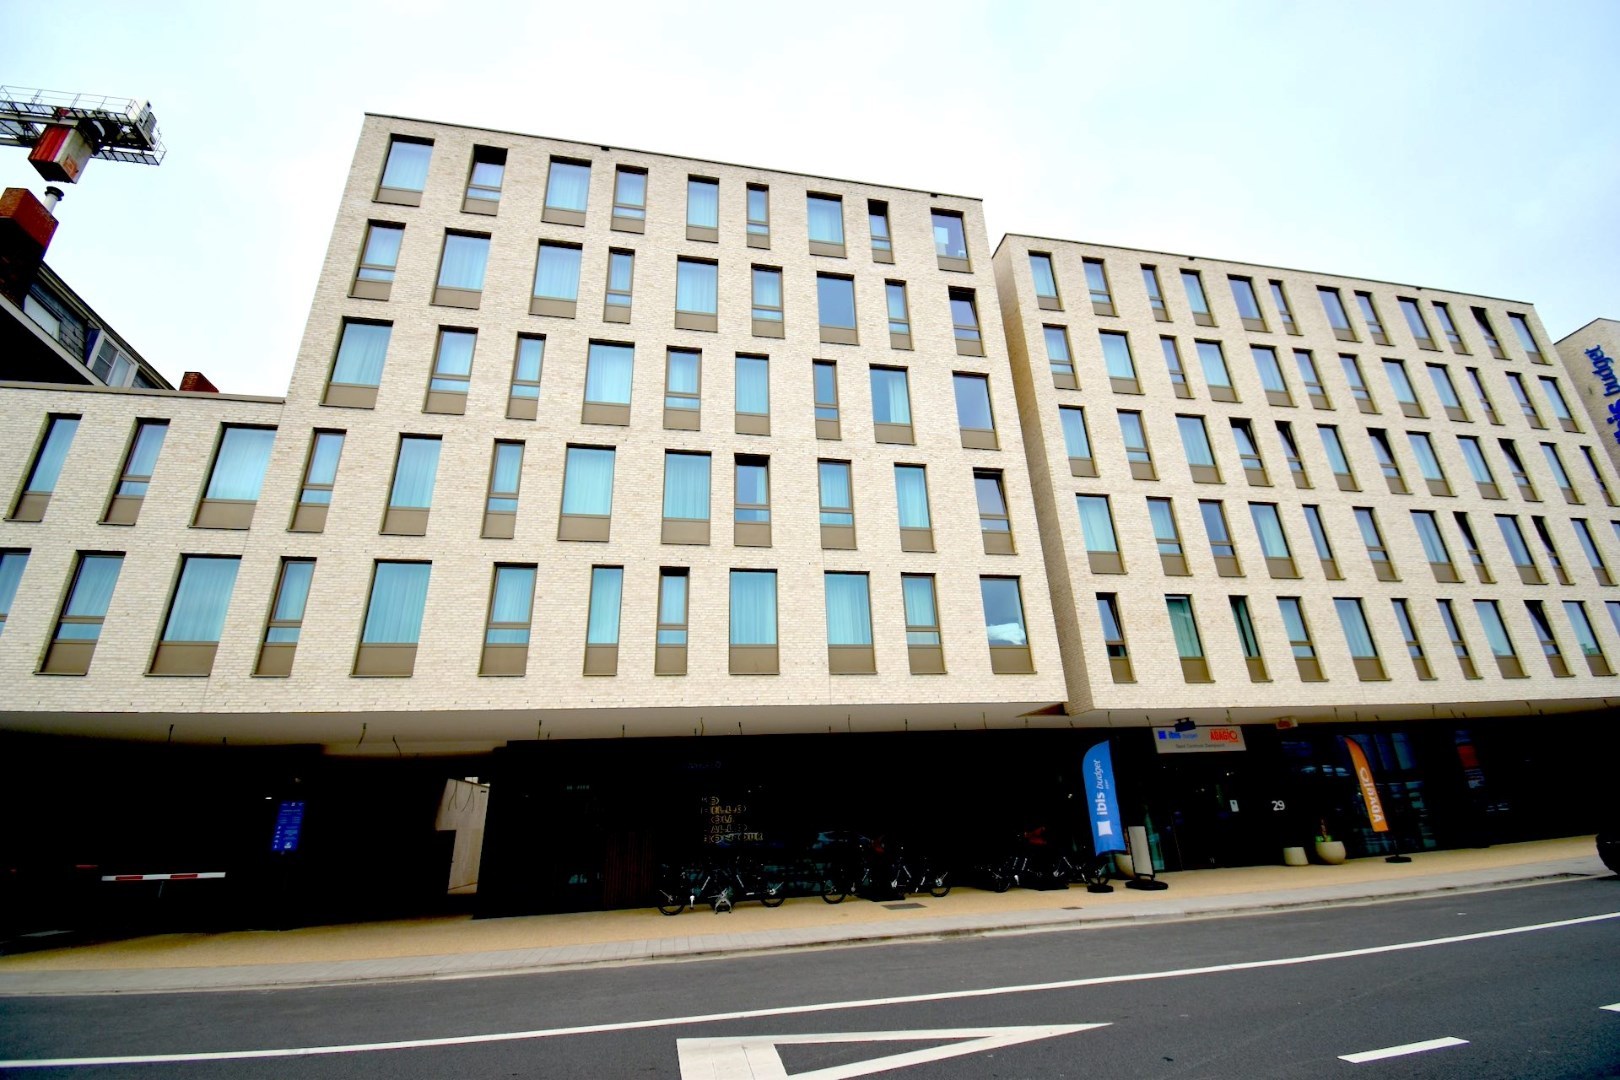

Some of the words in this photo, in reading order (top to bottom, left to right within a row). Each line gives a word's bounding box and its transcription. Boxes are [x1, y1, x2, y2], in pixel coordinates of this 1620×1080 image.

[1584, 345, 1620, 397] budget
[1093, 759, 1104, 790] budget
[1095, 791, 1108, 816] ibis
[1271, 800, 1285, 811] 29
